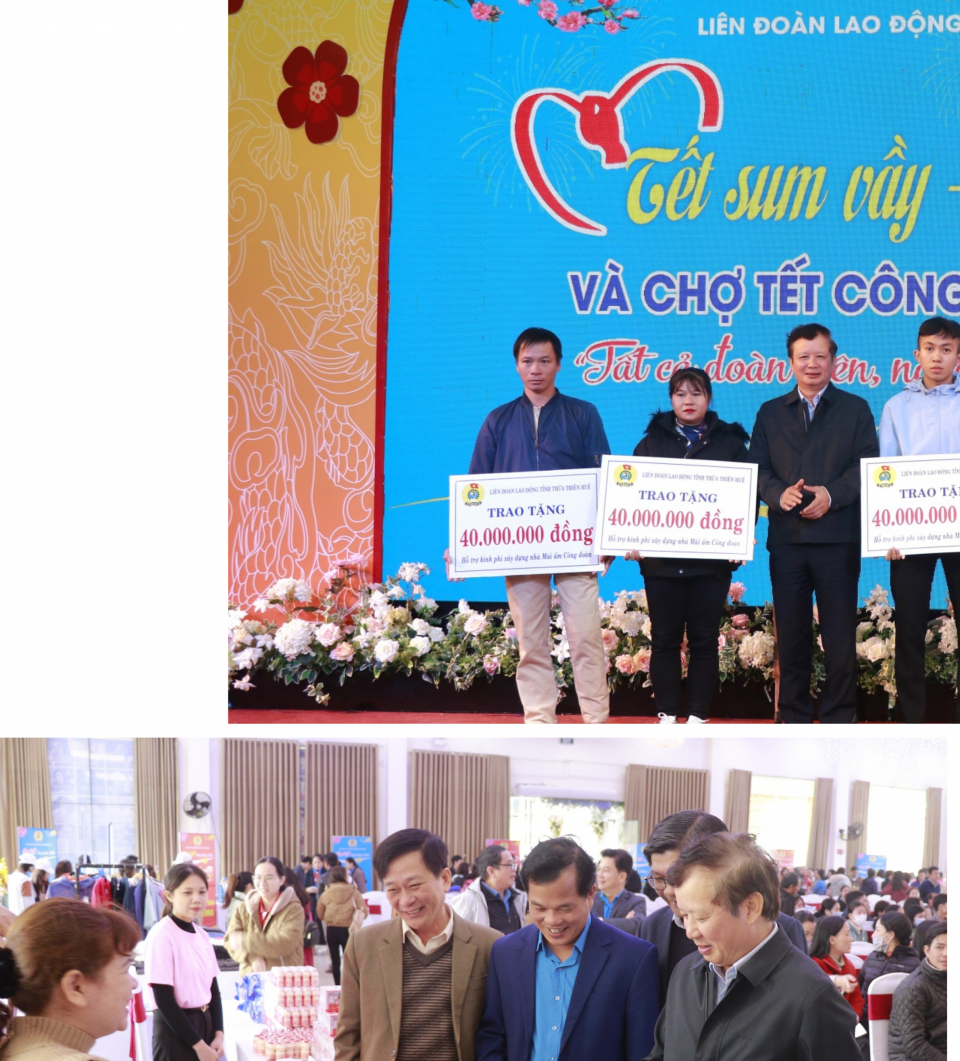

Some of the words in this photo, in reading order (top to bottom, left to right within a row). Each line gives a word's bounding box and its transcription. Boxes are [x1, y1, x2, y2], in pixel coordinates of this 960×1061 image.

[698, 12, 745, 36] LIÊN
[754, 12, 826, 35] ĐOÀN
[833, 16, 880, 35] LAO
[626, 135, 715, 225] Tết
[724, 163, 829, 222] sum
[842, 135, 933, 243] vầy
[568, 259, 633, 315] VÀ
[641, 265, 746, 327] CHỢ
[754, 253, 824, 315] TẾT
[705, 333, 795, 384] đoàn
[830, 352, 882, 388] ên,
[639, 491, 675, 500] TRAO
[680, 491, 716, 504] TẶNG
[900, 488, 936, 498] TRAO
[488, 507, 524, 517] TRAO
[528, 504, 564, 517] TẶNG
[608, 508, 694, 528] 40.000.000
[700, 509, 744, 535] đồng
[872, 506, 957, 526] 40.000.000
[460, 525, 544, 546] 40.000.000
[550, 520, 593, 545] đồng
